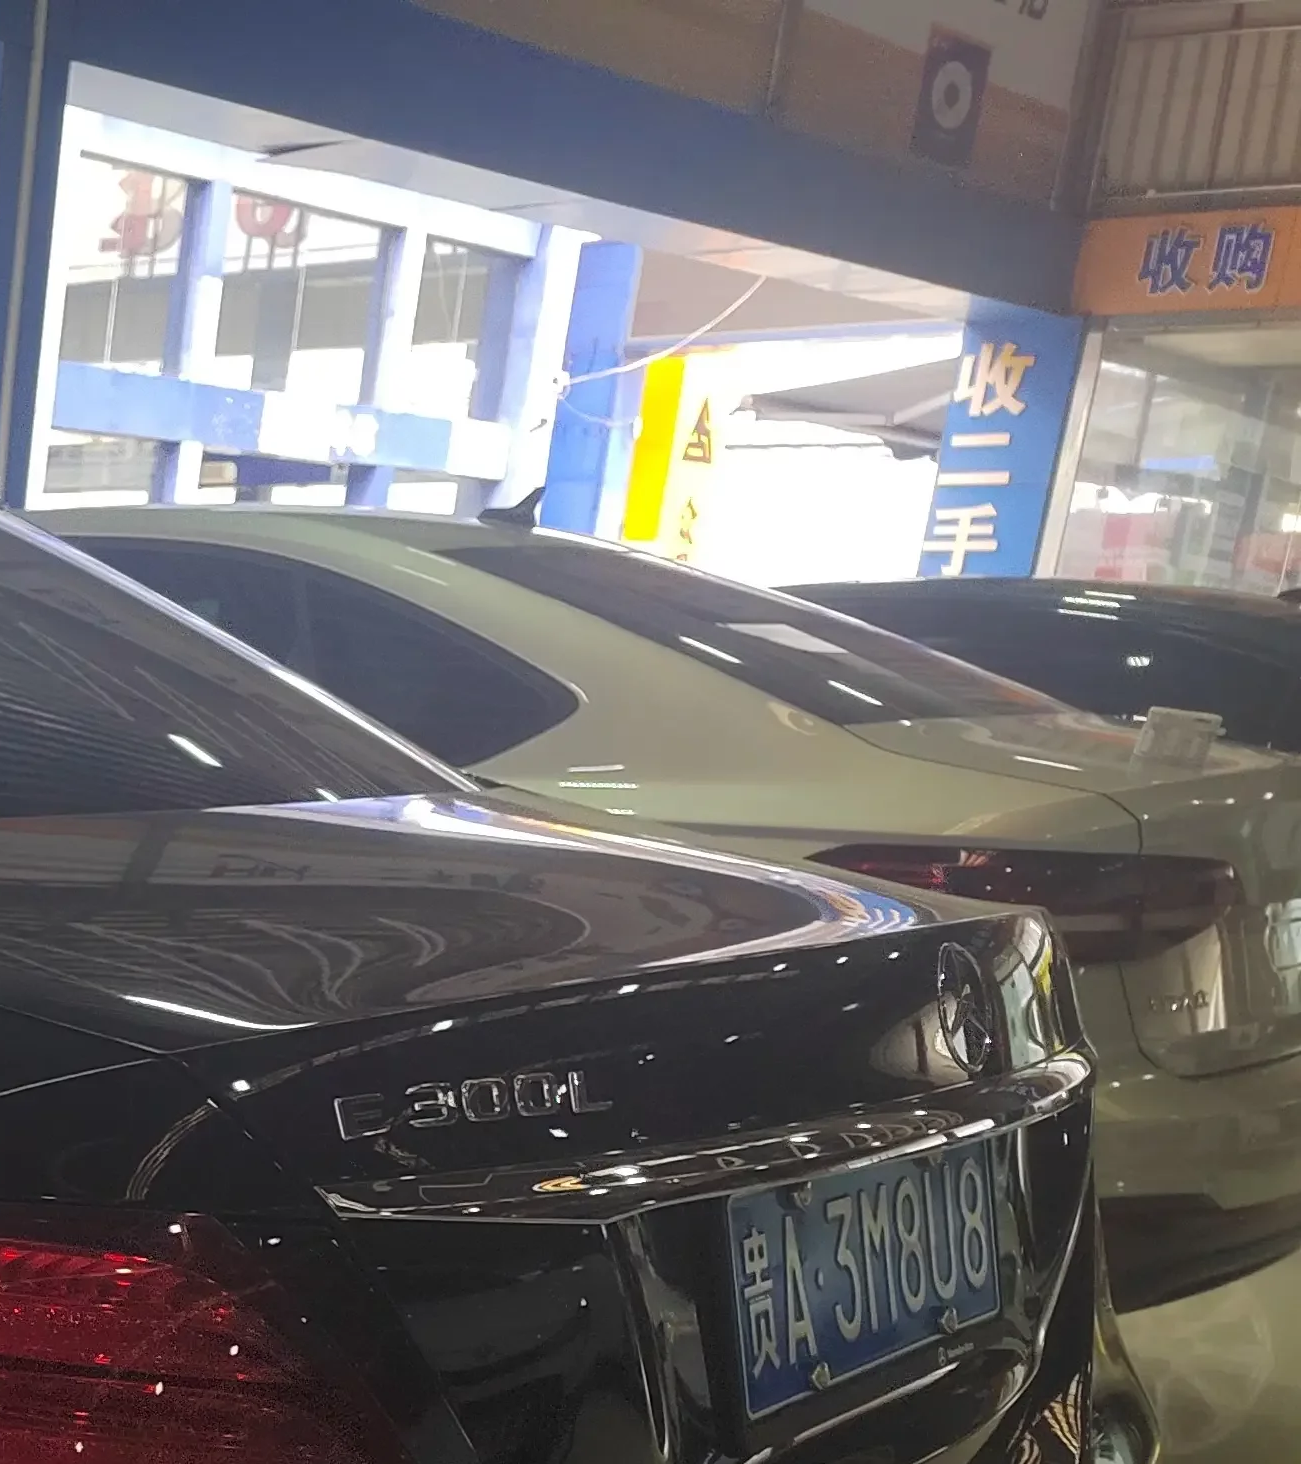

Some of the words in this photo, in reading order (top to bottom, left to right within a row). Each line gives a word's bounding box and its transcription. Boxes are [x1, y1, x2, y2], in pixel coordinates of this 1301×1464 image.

[1137, 223, 1274, 295] 收购
[921, 342, 1036, 577] 收二手
